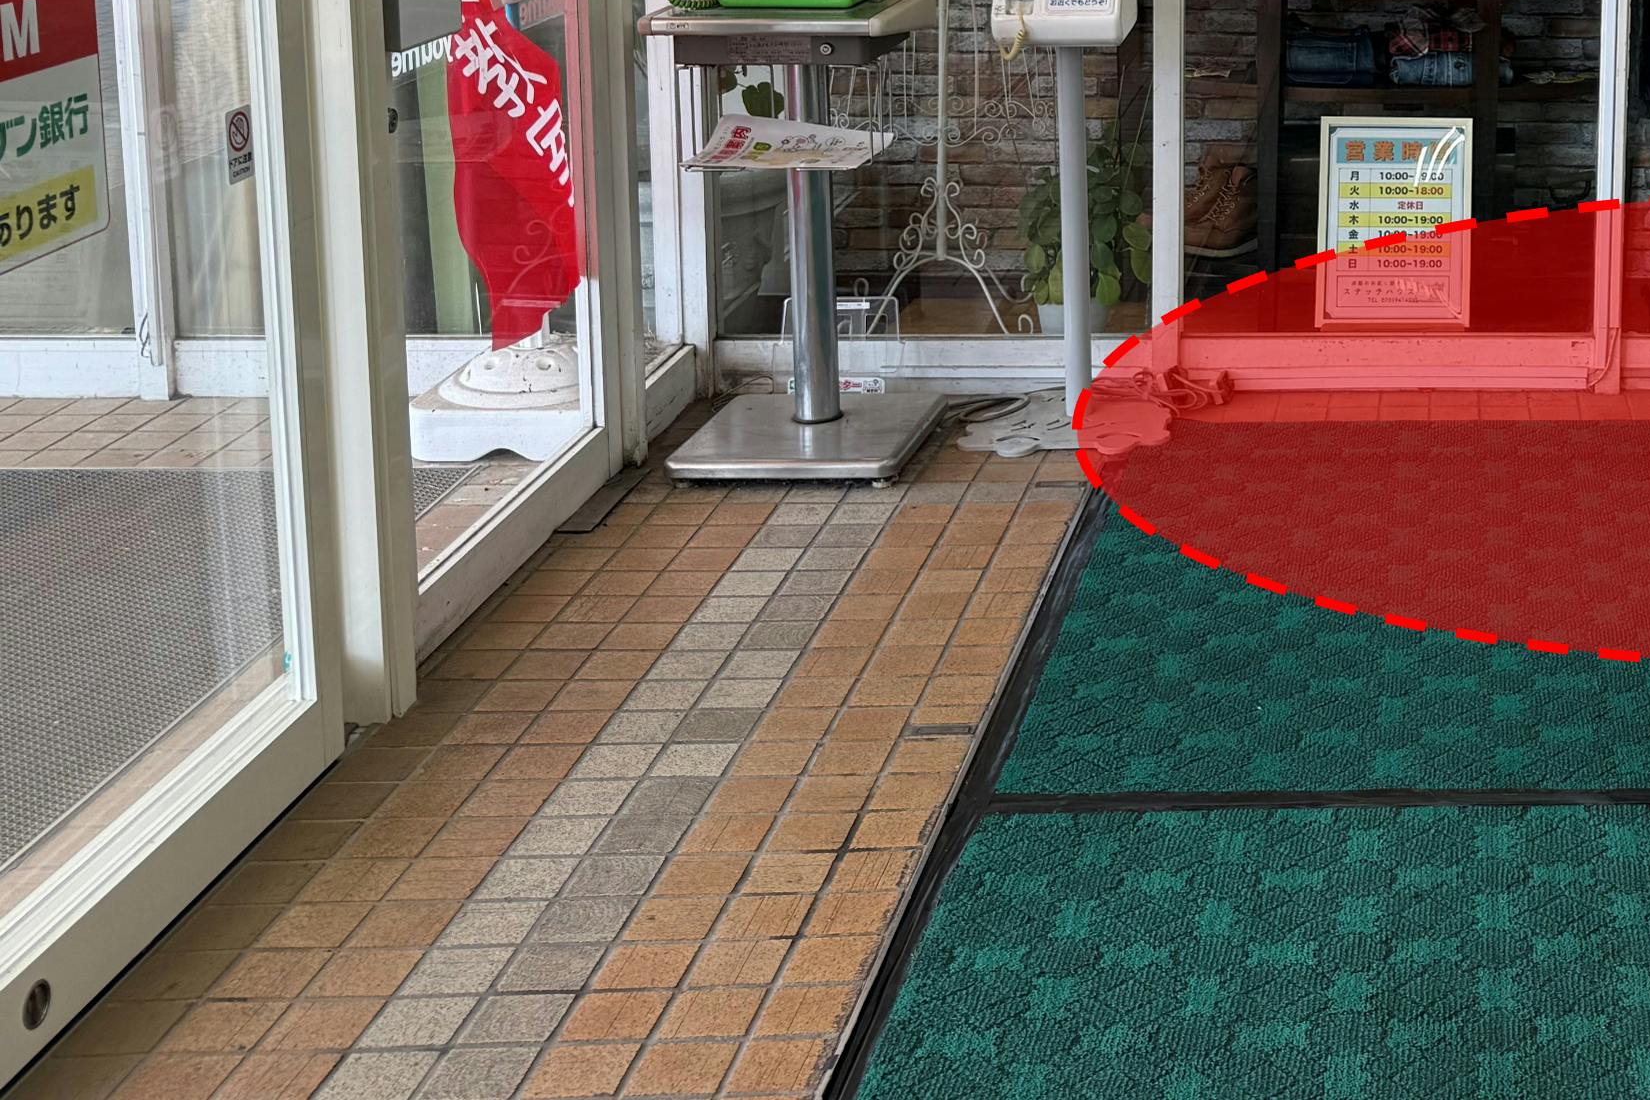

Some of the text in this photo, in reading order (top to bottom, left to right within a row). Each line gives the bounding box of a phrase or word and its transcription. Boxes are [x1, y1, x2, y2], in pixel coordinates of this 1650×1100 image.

[1350, 171, 1444, 181] 月 10:00~9:00
[1350, 186, 1359, 196] 火
[1349, 201, 1424, 210] 水 定休日
[1349, 215, 1359, 225] 木
[1348, 230, 1359, 240] 金
[1348, 245, 1358, 254] 土
[1348, 259, 1357, 269] 日
